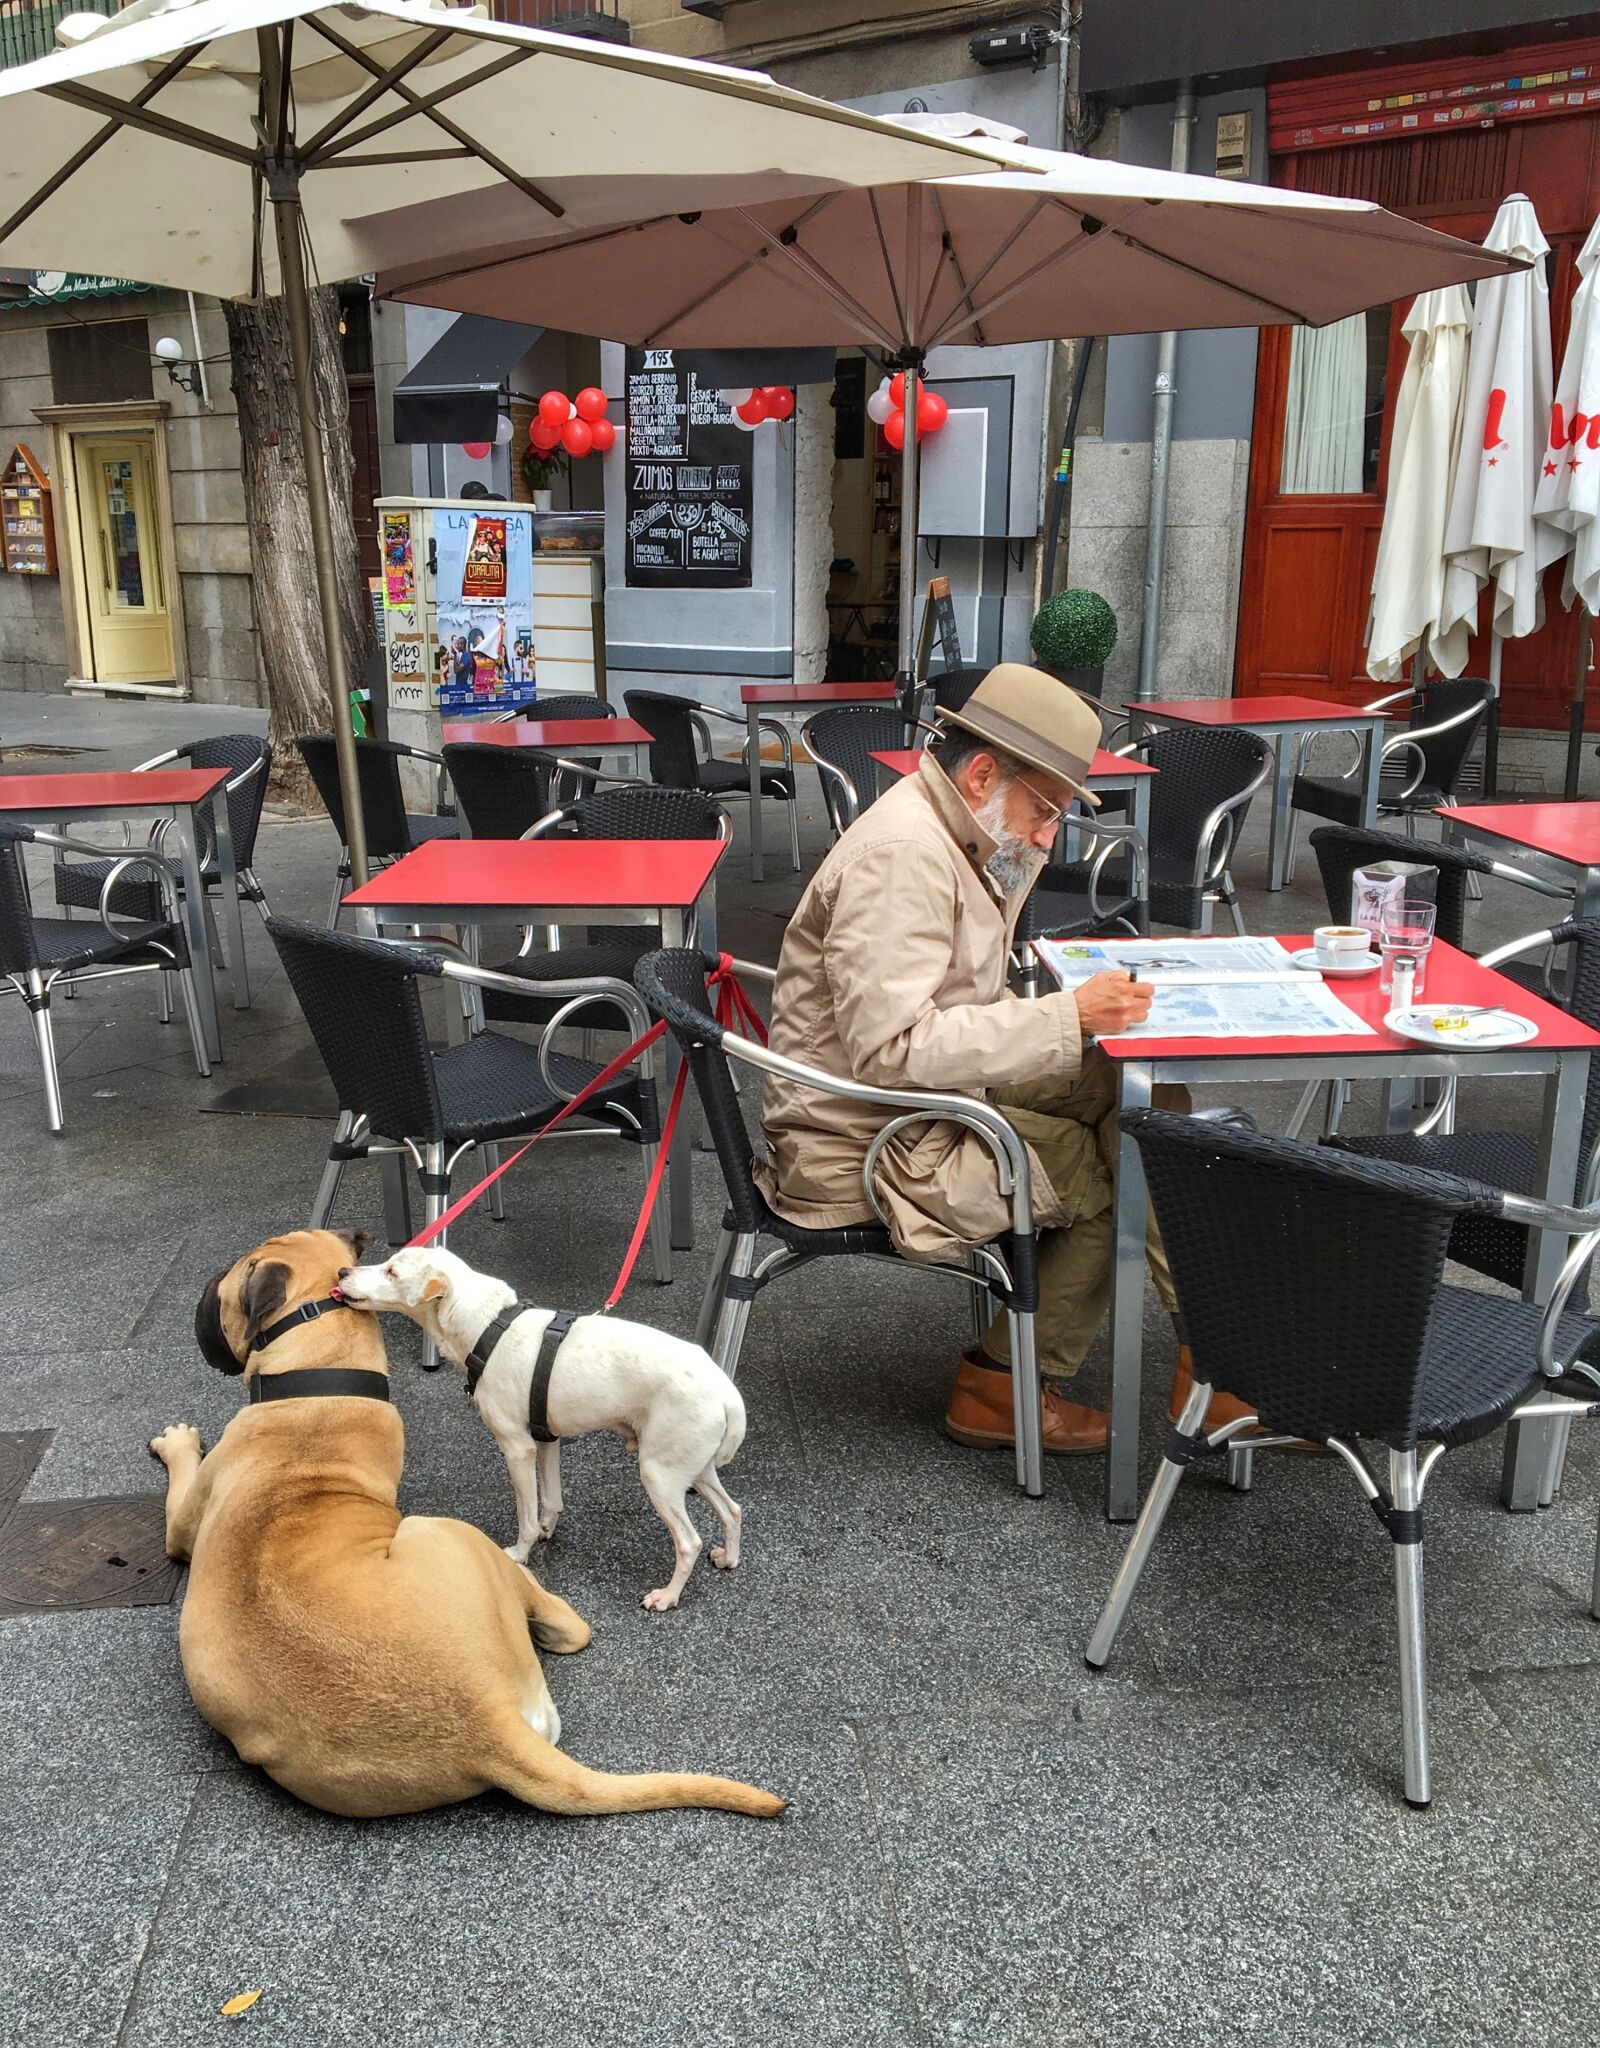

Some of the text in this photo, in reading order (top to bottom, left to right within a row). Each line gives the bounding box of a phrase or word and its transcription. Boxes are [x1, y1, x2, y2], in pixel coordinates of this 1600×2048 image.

[73, 276, 98, 292] Madrid,
[99, 277, 117, 288] desde
[651, 373, 677, 384] SERRANO
[629, 385, 654, 395] CHORIZO
[651, 395, 656, 405] Y
[657, 395, 676, 405] QUESO
[657, 415, 677, 426] PATATA
[691, 413, 711, 425] QUESO
[630, 436, 657, 446] VEGETAL
[630, 444, 683, 456] MIXTO AGUACATE
[633, 465, 673, 490] ZUMOS
[644, 491, 726, 500] NATURAL FRESH JUICES
[448, 515, 468, 529] LA
[711, 502, 748, 537] BOCADILLOS
[693, 536, 719, 547] BOTELLA
[636, 544, 665, 555] BOCADILLO
[693, 549, 701, 560] DE
[701, 548, 720, 561] AGUA
